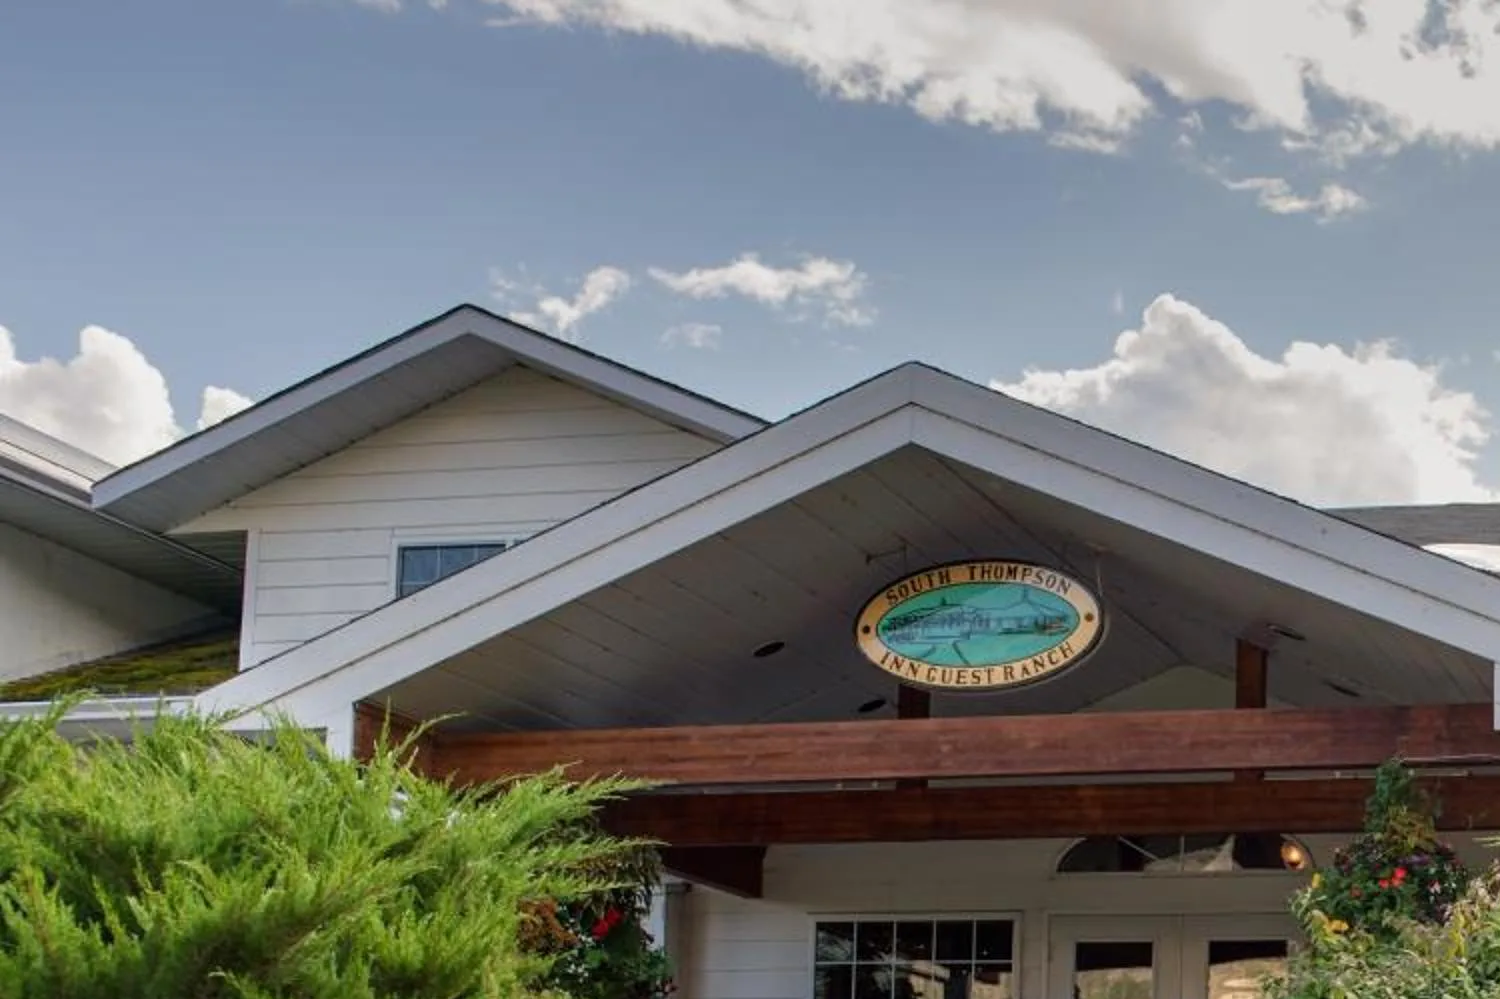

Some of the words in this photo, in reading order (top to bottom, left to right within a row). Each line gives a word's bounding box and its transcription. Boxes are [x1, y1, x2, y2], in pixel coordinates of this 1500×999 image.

[886, 570, 952, 607] SOUTH
[967, 565, 1071, 596] THOMPSON
[880, 651, 919, 678] INN
[925, 666, 996, 685] GUEST
[1003, 643, 1076, 682] RANCH
